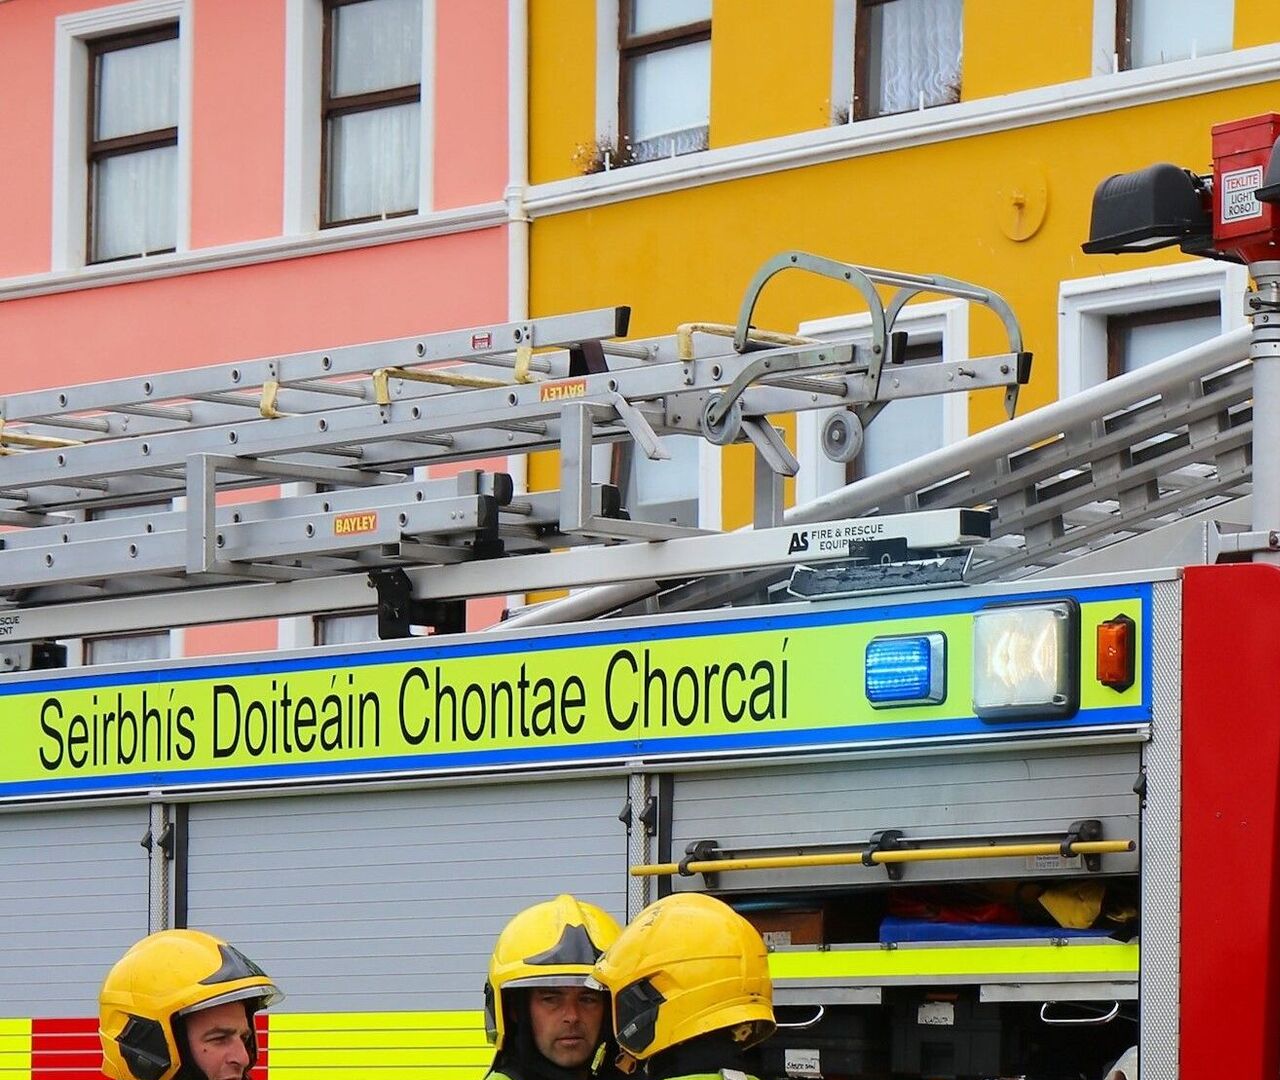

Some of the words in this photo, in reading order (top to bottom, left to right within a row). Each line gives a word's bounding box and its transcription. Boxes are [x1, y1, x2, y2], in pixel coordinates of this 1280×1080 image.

[1226, 173, 1259, 190] TEKLITE
[1231, 191, 1254, 205] LIGHT
[1229, 202, 1256, 216] ROBOT
[335, 514, 376, 534] BAYLEY
[811, 529, 832, 540] FIRE
[835, 528, 841, 537] &
[844, 523, 884, 536] RESCUE
[787, 531, 809, 555] AS
[39, 688, 196, 771] Seirbhís
[213, 673, 380, 759] Doiteáin
[399, 661, 586, 746] Chontae
[605, 637, 789, 731] Chorcaí
